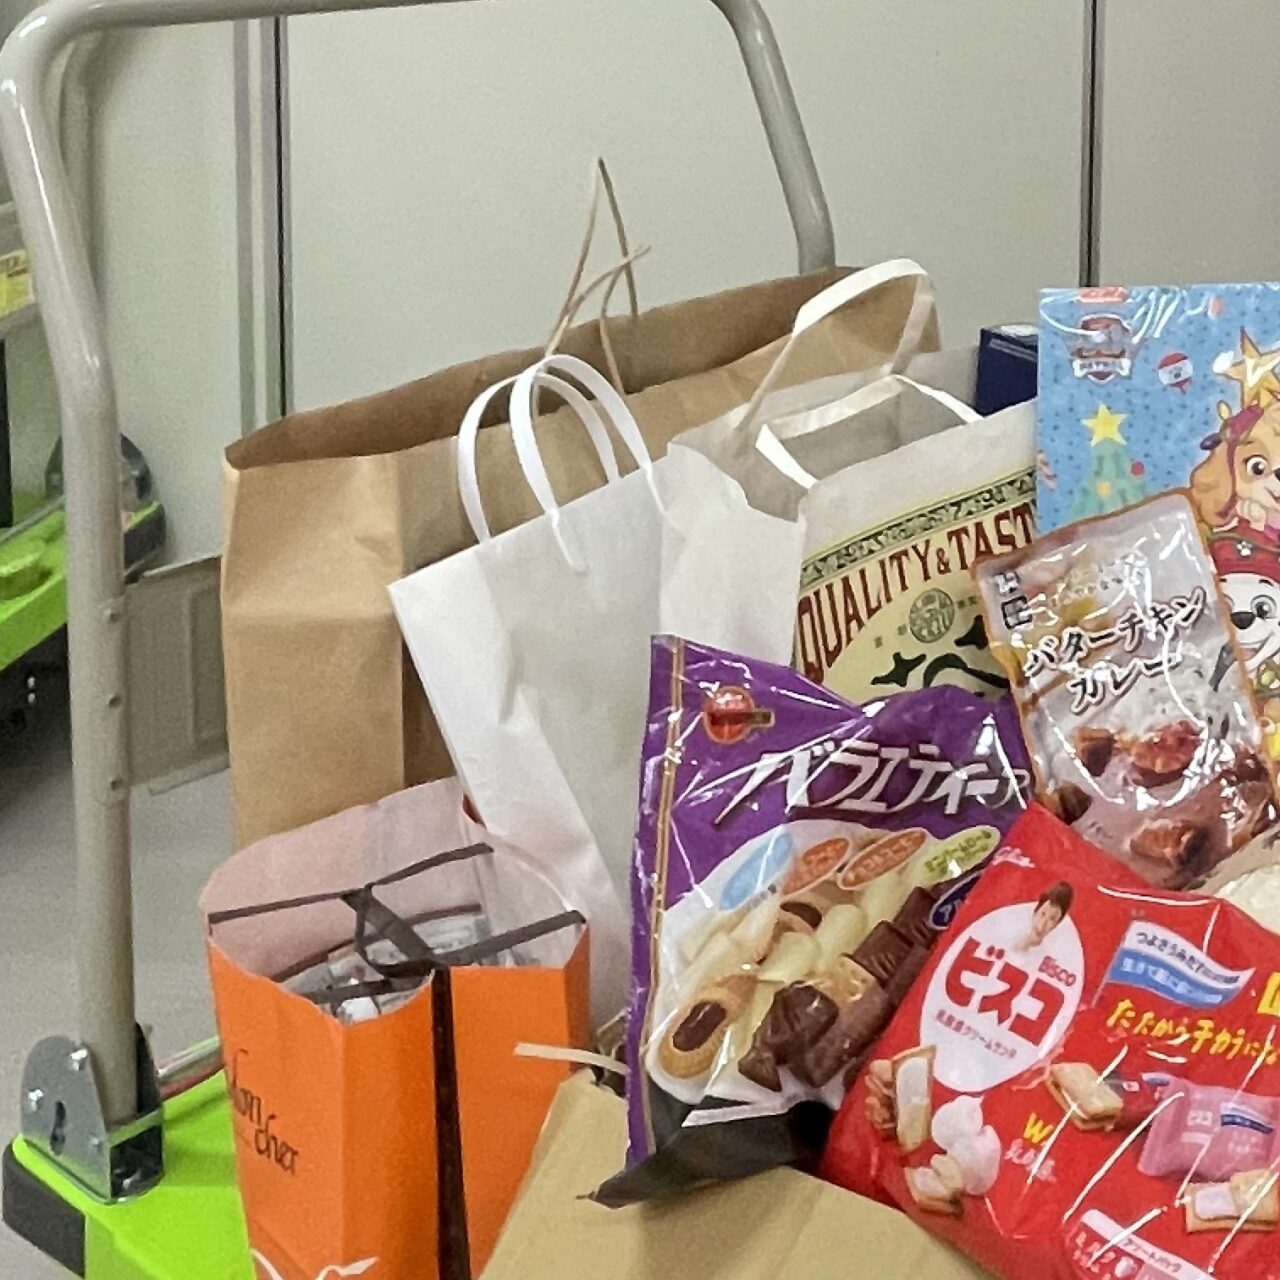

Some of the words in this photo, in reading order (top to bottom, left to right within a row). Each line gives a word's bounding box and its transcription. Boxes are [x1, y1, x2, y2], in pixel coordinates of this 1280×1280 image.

[1024, 588, 1206, 676] バターチキン
[945, 936, 1065, 1047] ビスコ
